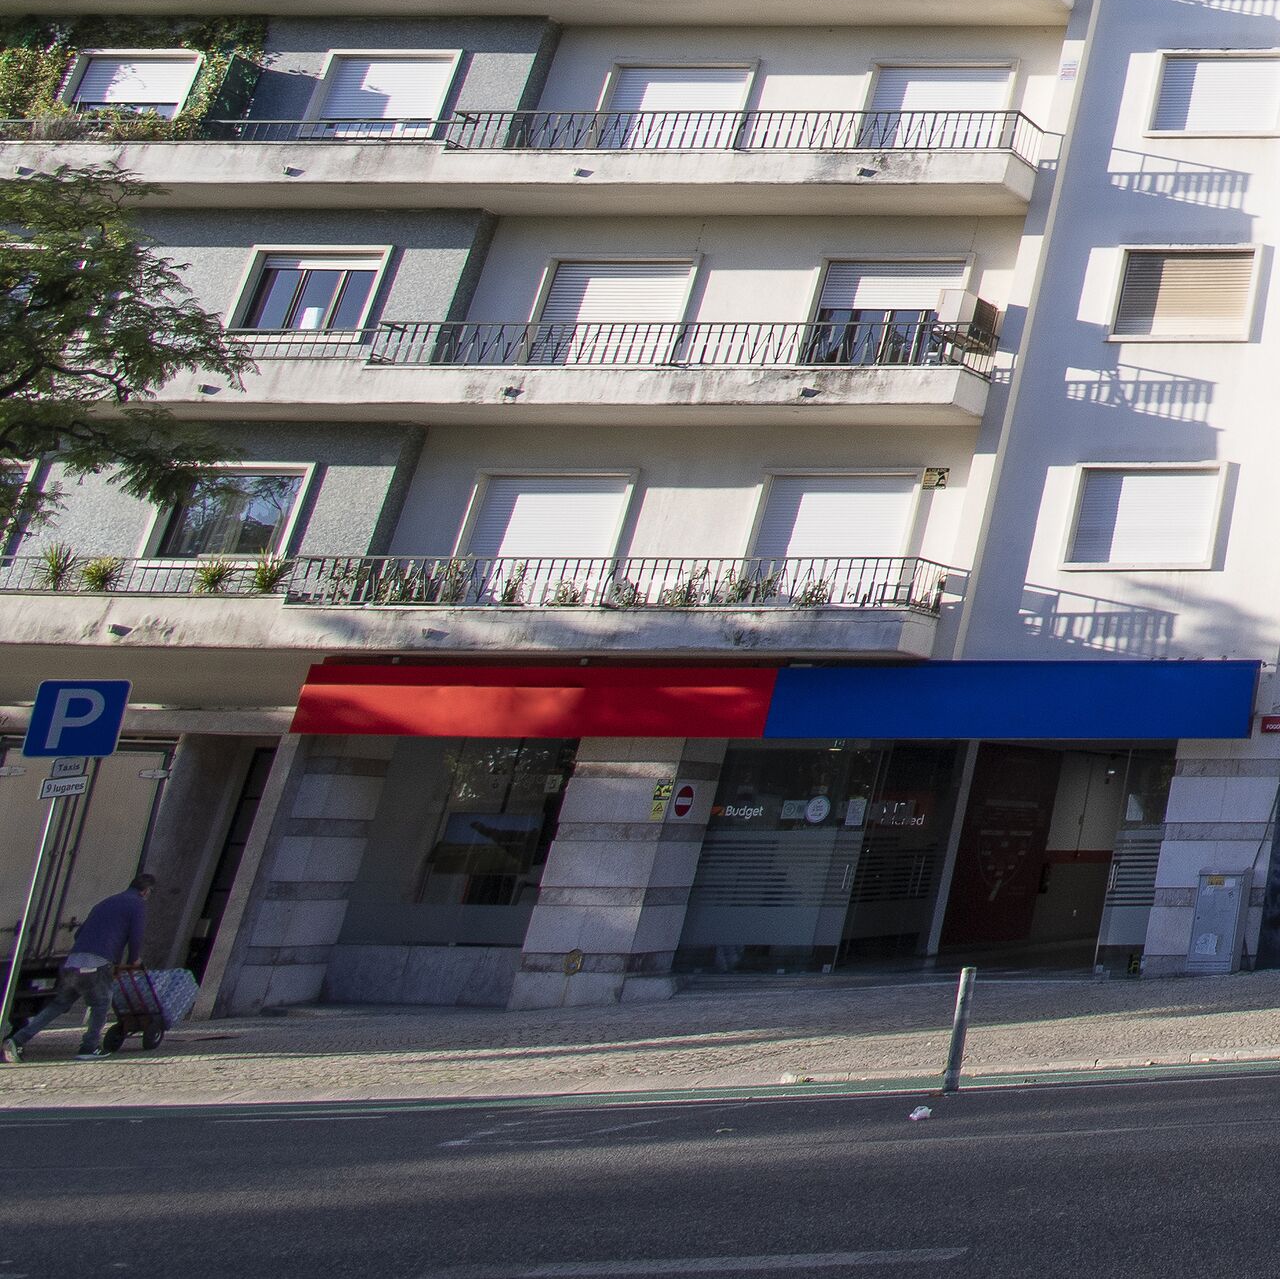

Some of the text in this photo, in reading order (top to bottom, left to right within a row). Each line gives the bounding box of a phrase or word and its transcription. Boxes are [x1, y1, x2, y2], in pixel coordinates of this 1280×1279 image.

[44, 688, 105, 749] P
[58, 763, 81, 773] Taxis
[46, 780, 84, 794] 9 lugares
[725, 805, 764, 819] Budget
